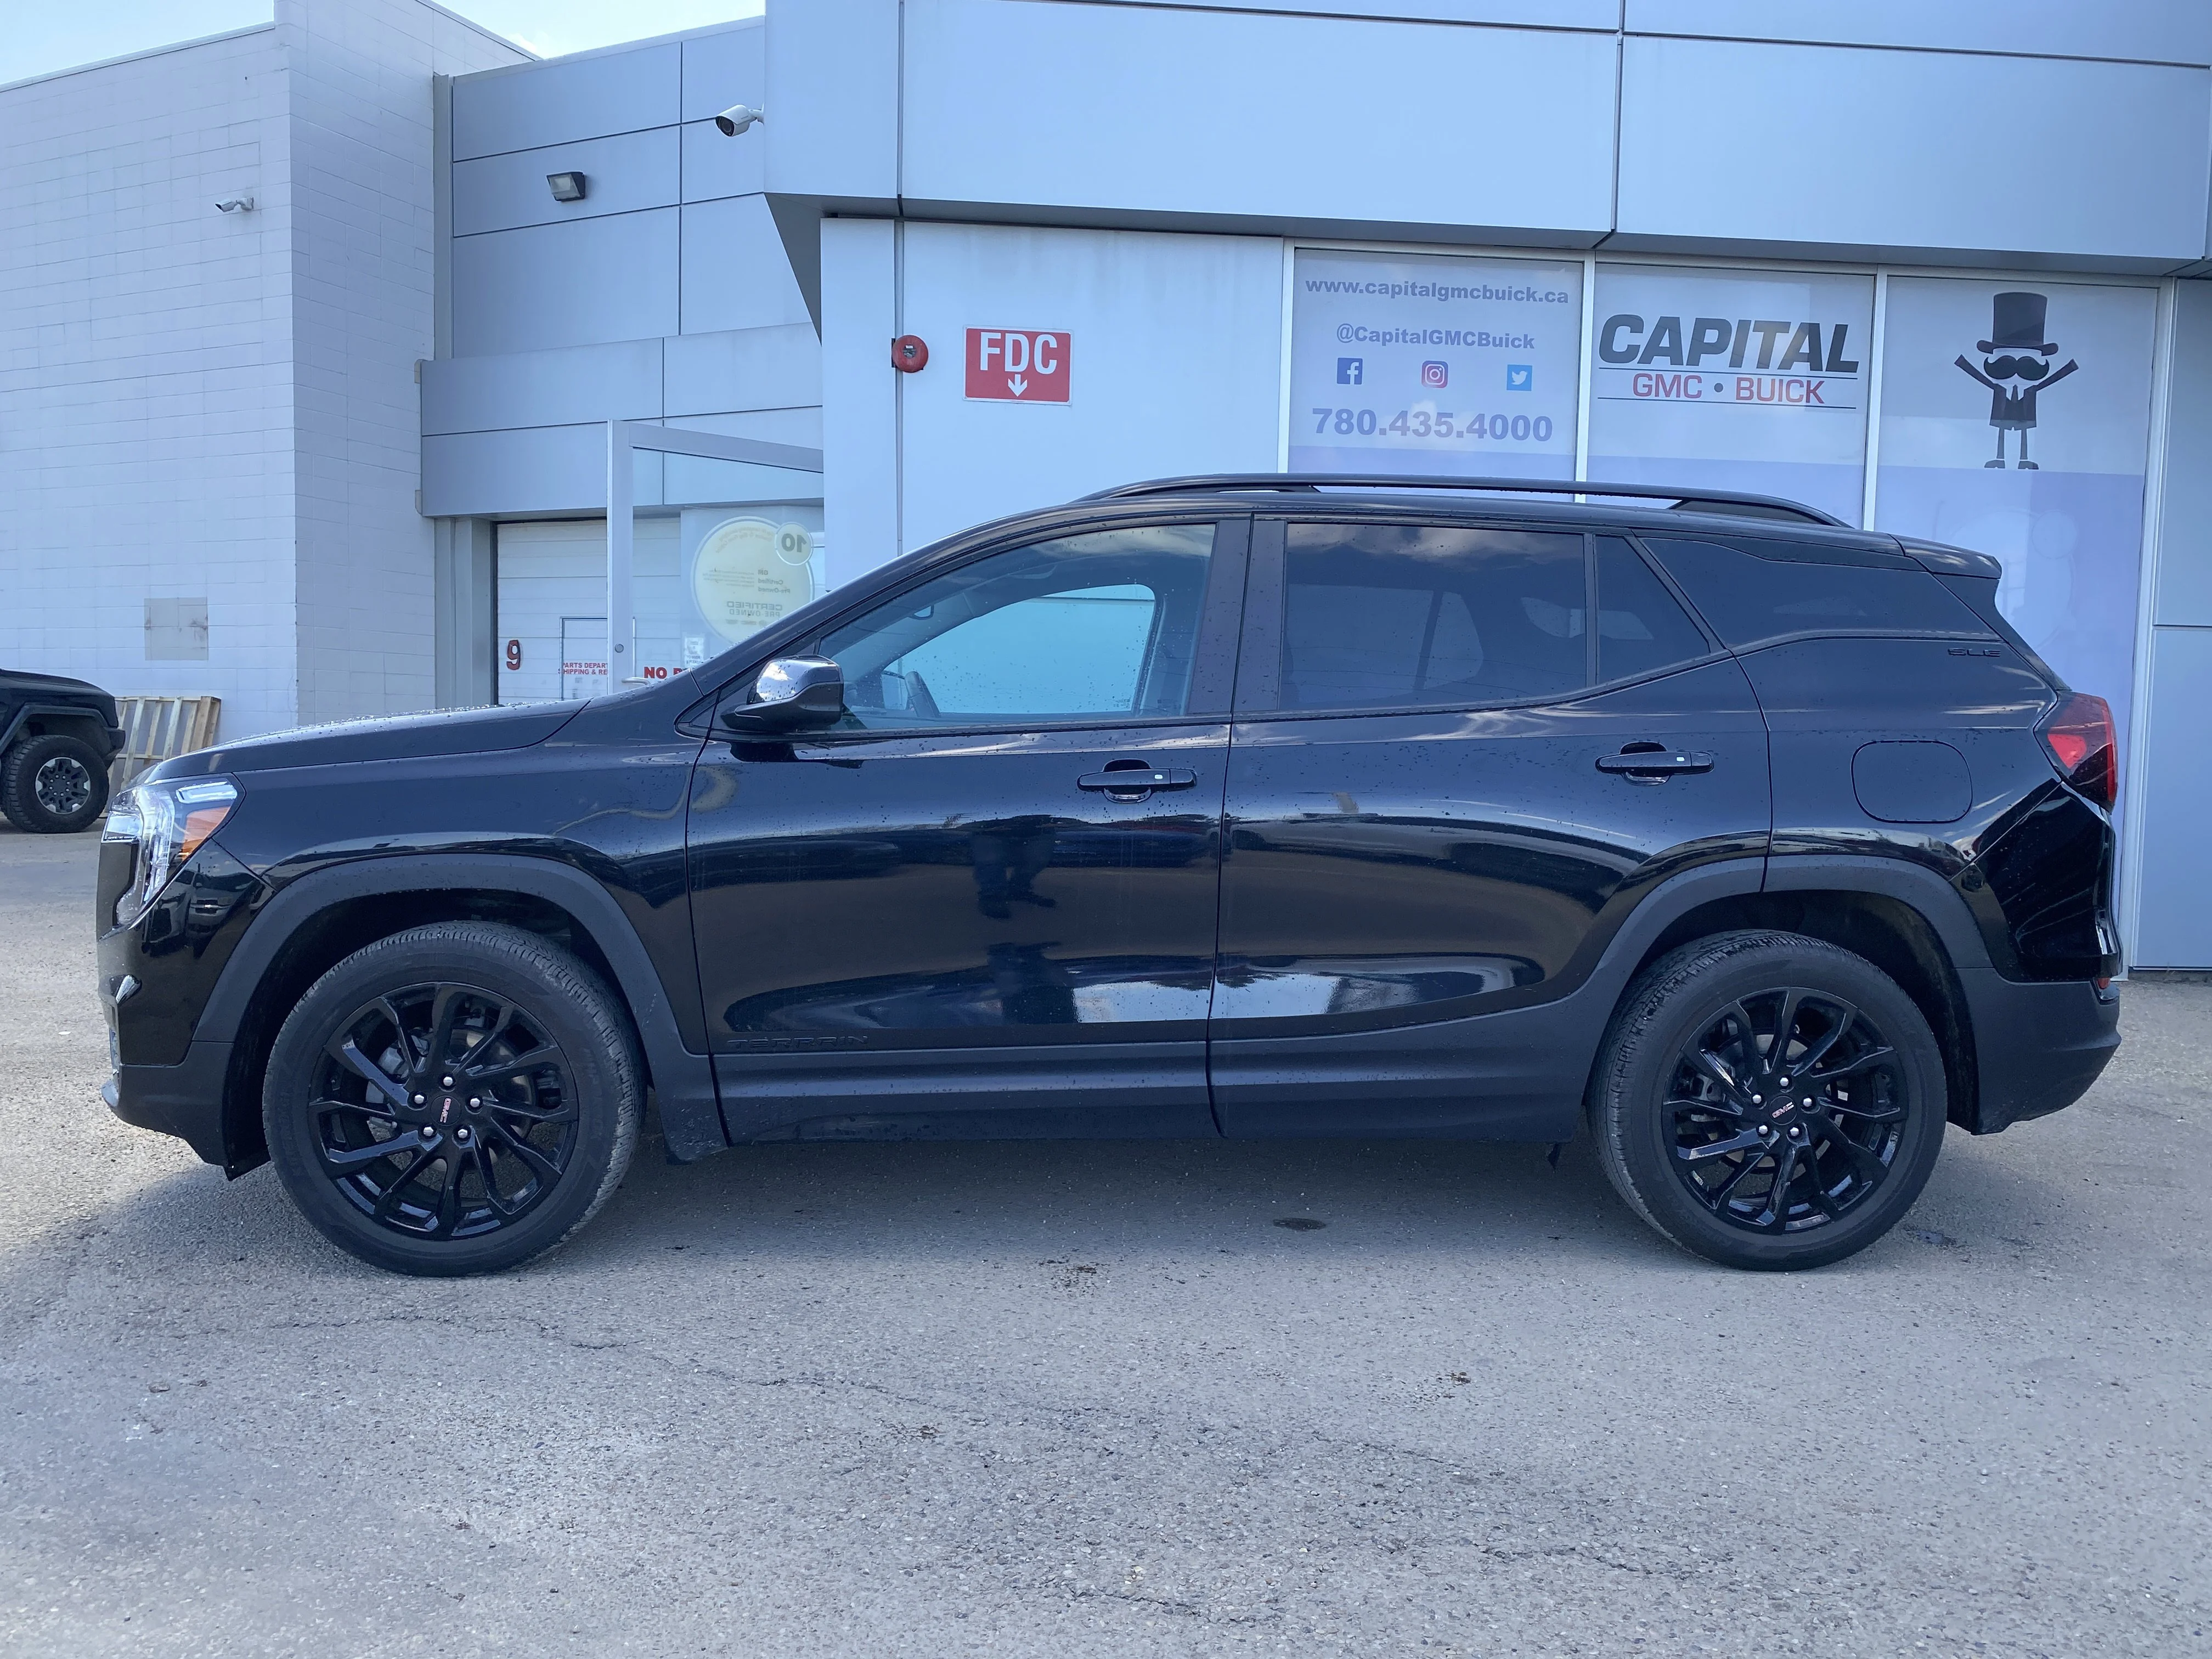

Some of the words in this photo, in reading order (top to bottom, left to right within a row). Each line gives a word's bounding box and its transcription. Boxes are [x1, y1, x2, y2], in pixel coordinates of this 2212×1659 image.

[1306, 279, 1568, 303] www.capitalgmcbuick.ca
[1336, 323, 1534, 349] @CapitalGMCBuick
[1599, 314, 1859, 373] CAPITAL
[980, 332, 1057, 374] FDC
[1632, 373, 1702, 399] GMC
[1736, 377, 1825, 404] BUICK
[1312, 408, 1552, 441] 780.435.4000
[506, 640, 521, 670] 9
[1948, 648, 2001, 657] SLE
[644, 667, 667, 679] NO
[440, 1098, 451, 1122] GMC
[1772, 1102, 1794, 1118] GMC
